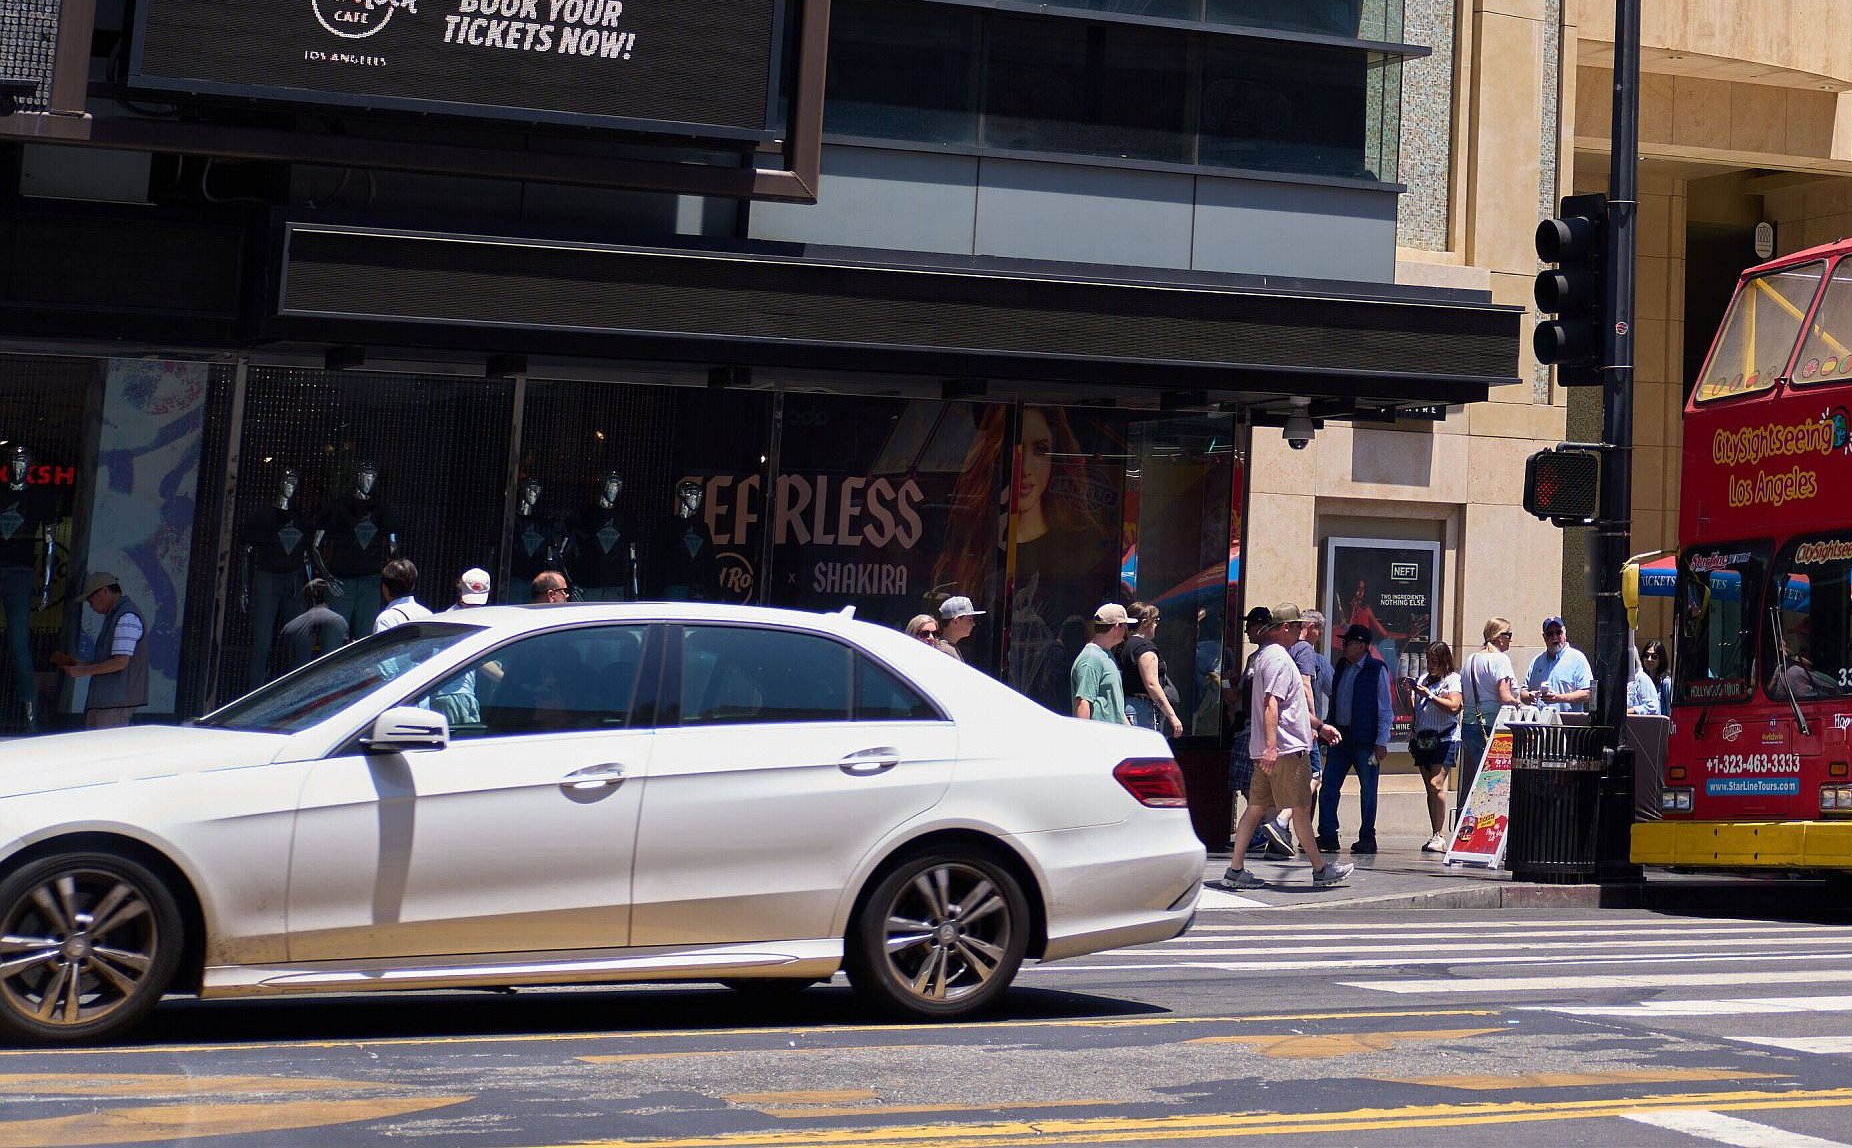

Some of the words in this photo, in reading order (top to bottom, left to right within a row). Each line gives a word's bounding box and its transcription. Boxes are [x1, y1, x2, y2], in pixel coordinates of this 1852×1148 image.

[443, 14, 555, 52] TICKETS
[558, 27, 635, 60] NOW!
[1713, 418, 1834, 467] CitySightseeing
[1729, 474, 1752, 507] Los
[1755, 465, 1817, 507] Angeles
[813, 560, 908, 596] SHAKIRA
[1394, 566, 1416, 577] NEFT
[1706, 753, 1800, 774] +1-323-463-3333
[1709, 781, 1796, 792] www.StarLineTours.com
